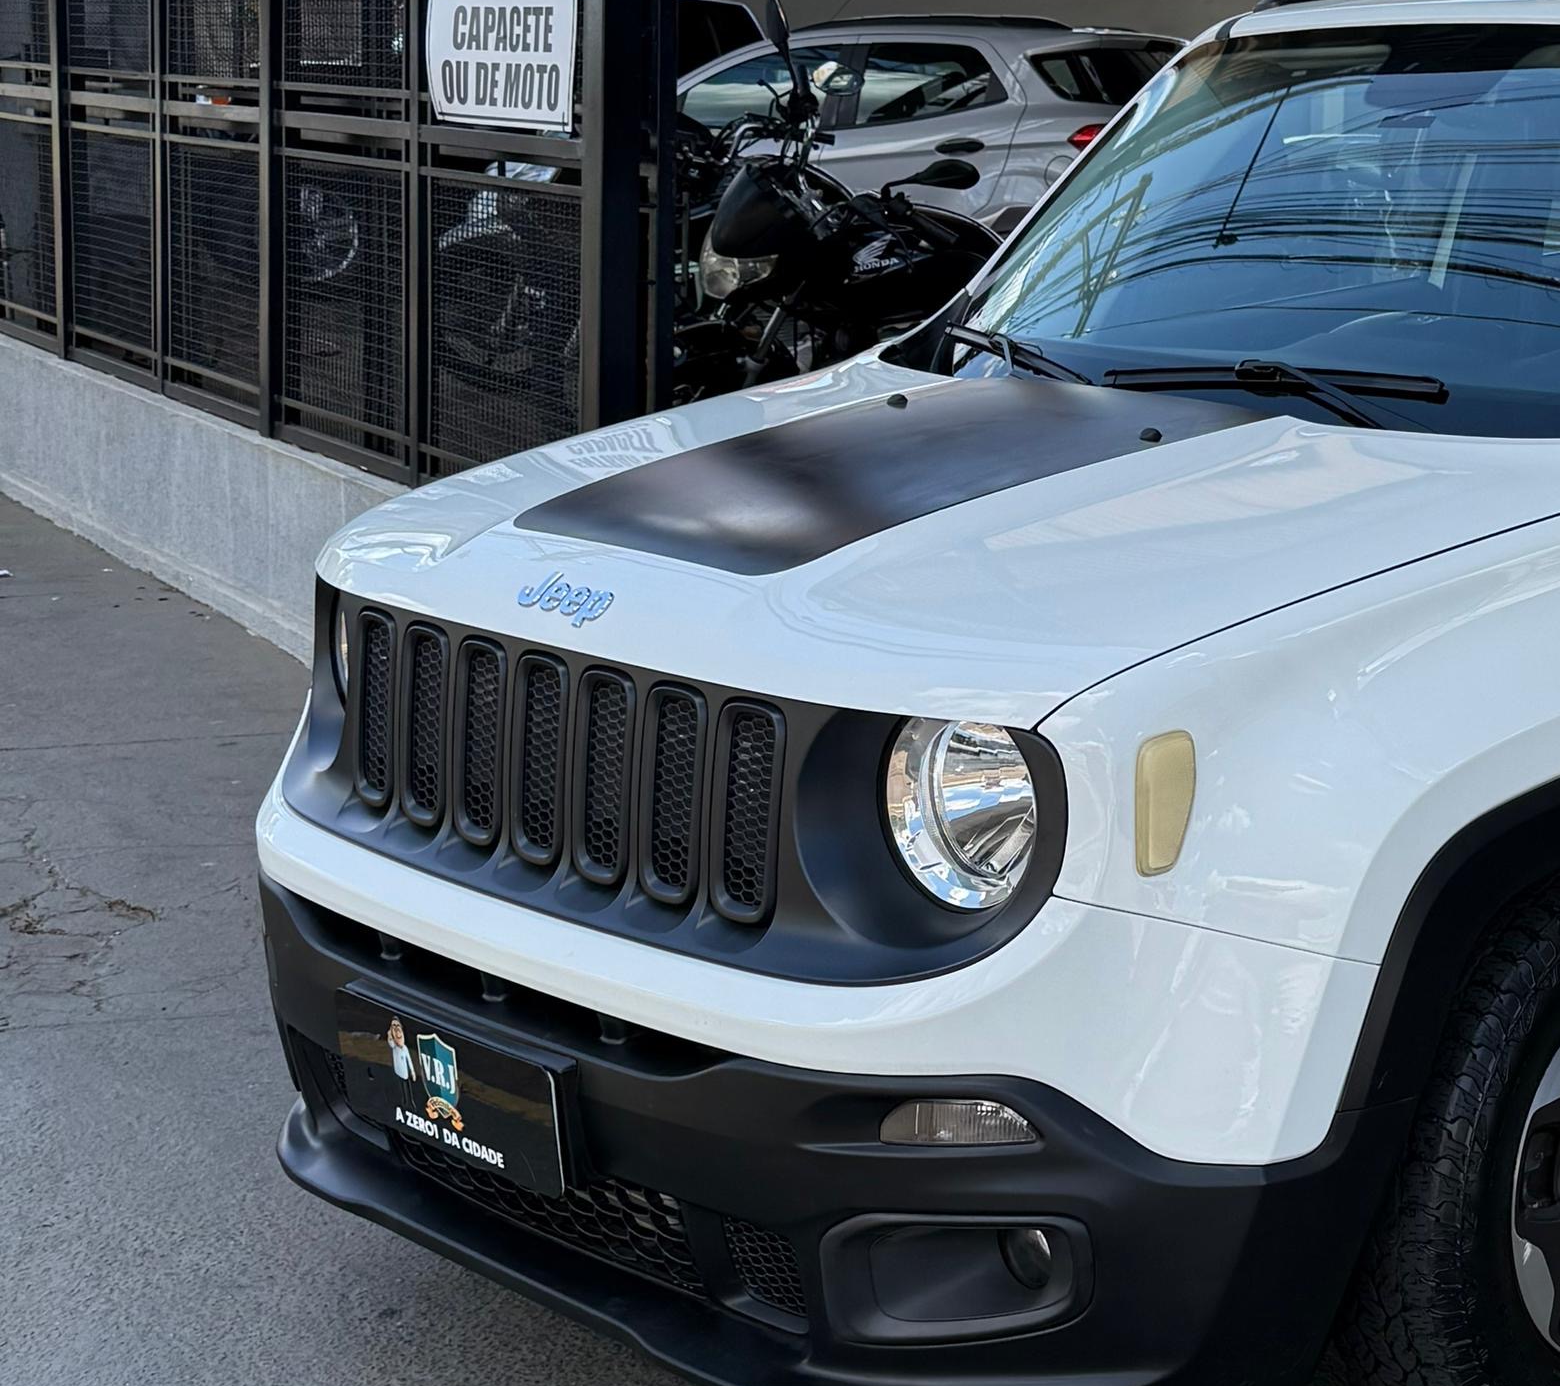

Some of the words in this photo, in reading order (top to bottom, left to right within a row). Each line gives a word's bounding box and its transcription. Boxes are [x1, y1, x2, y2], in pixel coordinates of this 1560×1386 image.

[453, 5, 554, 53] CAPACETE
[441, 59, 469, 105] OU
[475, 61, 500, 106] DE
[502, 63, 560, 111] MOTO
[853, 257, 899, 273] HONDA
[518, 572, 615, 628] Jeep
[421, 1053, 456, 1094] V.R.J
[395, 1106, 405, 1124] A
[442, 1128, 460, 1149] DA
[461, 1137, 505, 1169] CIDADE
